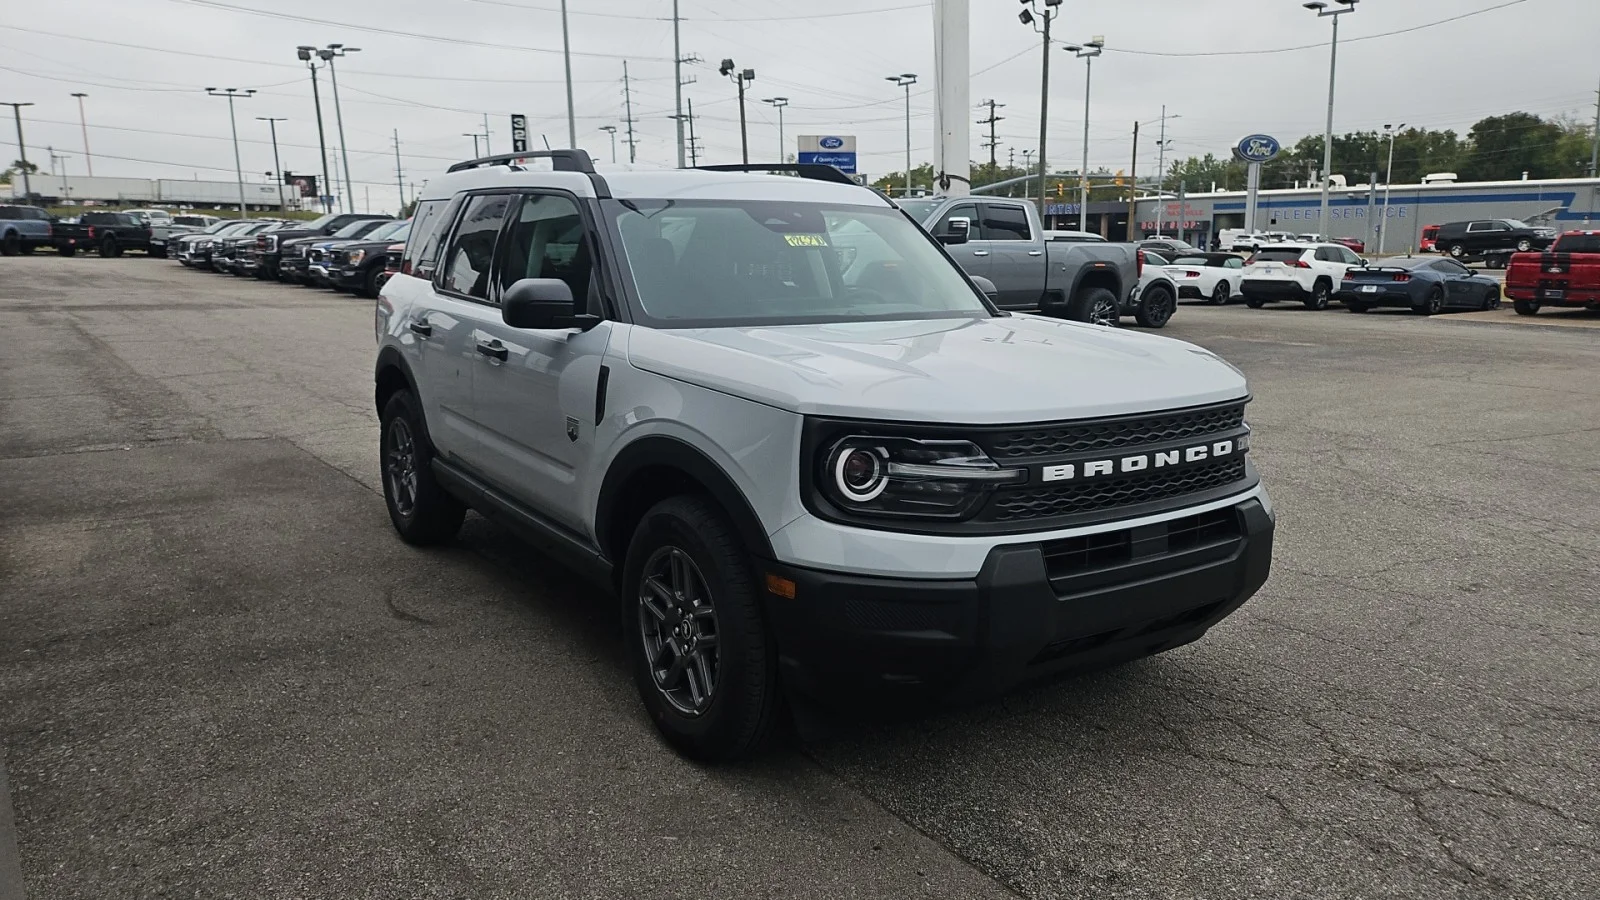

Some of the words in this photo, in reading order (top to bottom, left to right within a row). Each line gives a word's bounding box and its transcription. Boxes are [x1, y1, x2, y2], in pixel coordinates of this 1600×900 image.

[1246, 139, 1273, 156] Ford
[1273, 209, 1321, 220] FLEET
[1332, 206, 1407, 218] SERICE
[1042, 440, 1233, 482] BRONCO
